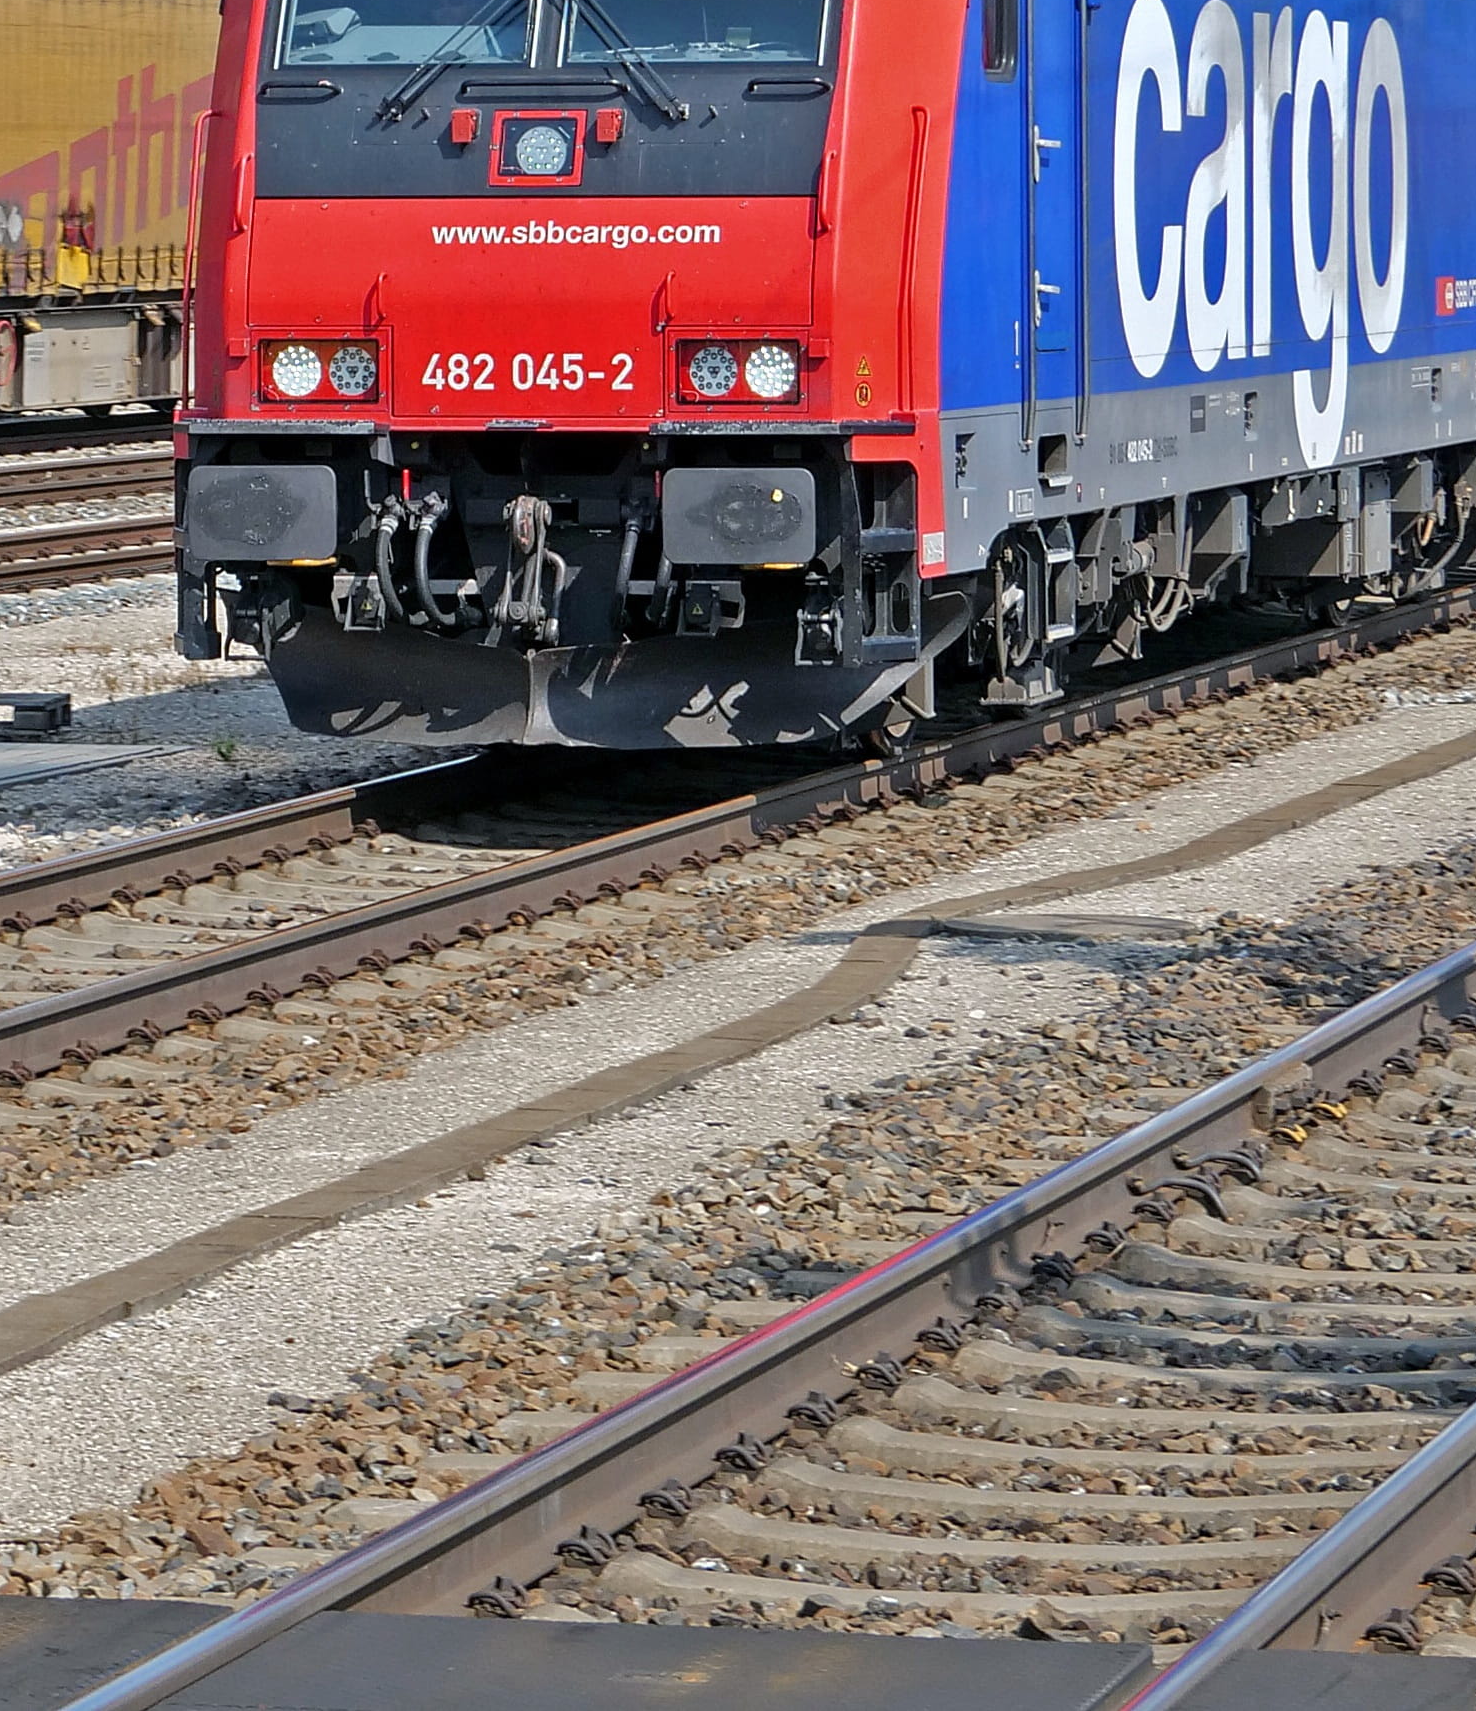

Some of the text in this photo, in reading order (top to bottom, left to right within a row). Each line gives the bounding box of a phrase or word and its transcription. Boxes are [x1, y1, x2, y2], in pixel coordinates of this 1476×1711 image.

[431, 220, 721, 249] www.sbbcargo.com
[421, 353, 635, 391] 482 045-2
